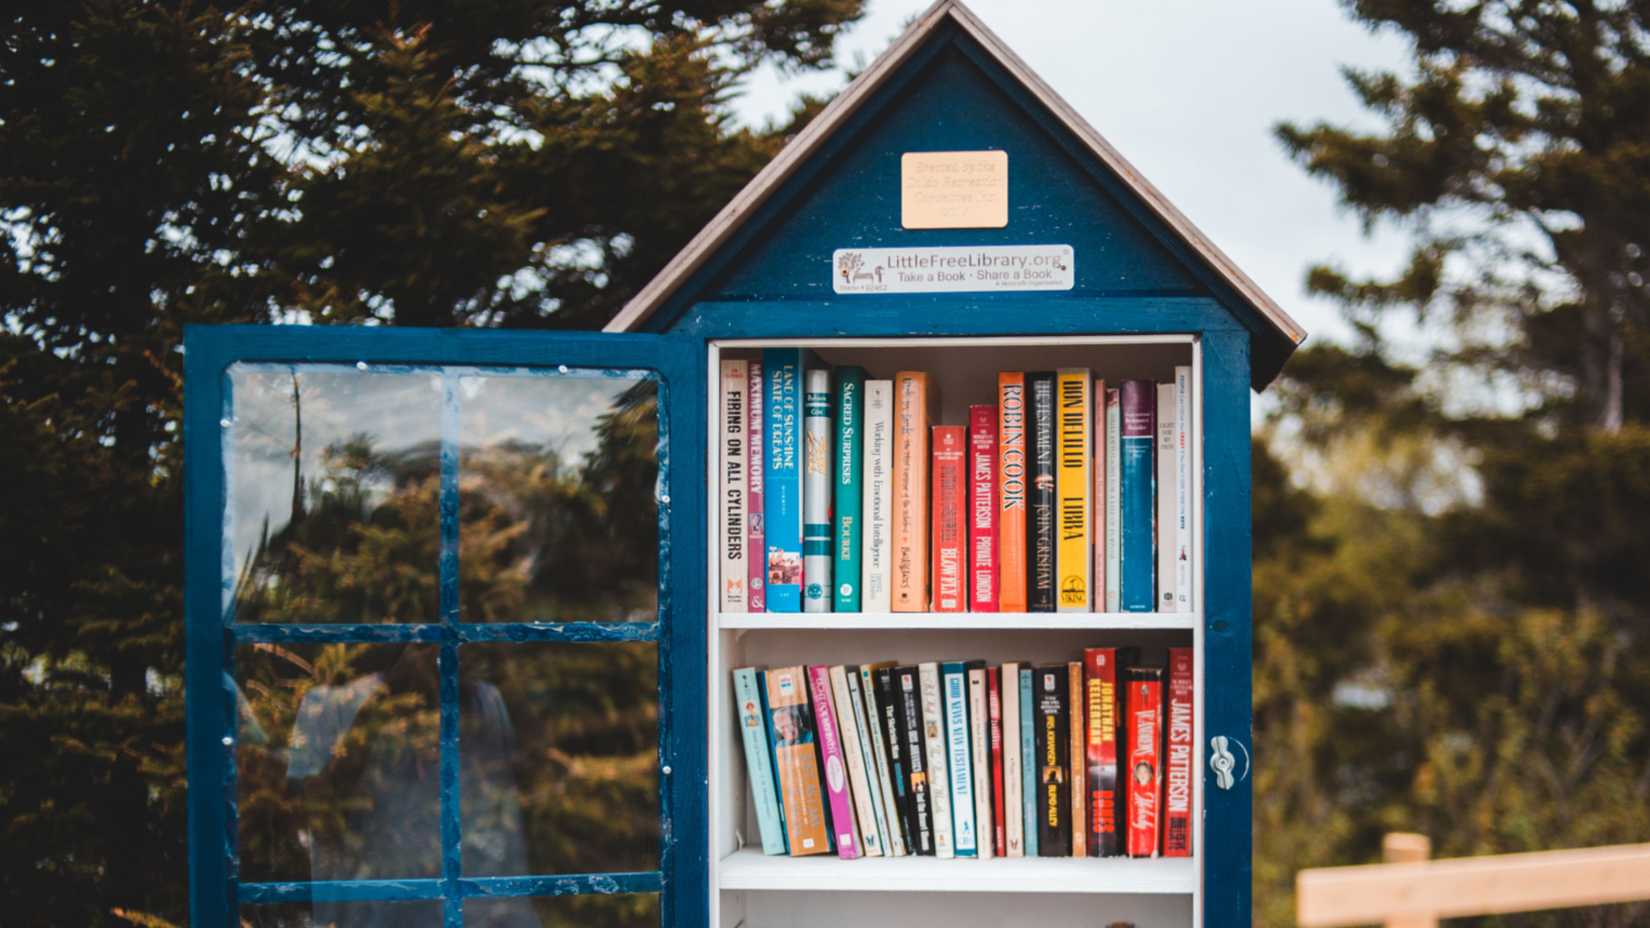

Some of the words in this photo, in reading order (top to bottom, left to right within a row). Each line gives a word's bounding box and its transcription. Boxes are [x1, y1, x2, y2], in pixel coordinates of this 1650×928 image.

[887, 252, 1062, 270] LittleFreeLibrary.org
[898, 271, 925, 283] Take
[927, 274, 934, 282] a
[937, 270, 966, 282] Book
[977, 269, 1011, 281] Share
[1013, 272, 1021, 280] a
[1024, 268, 1053, 280] Book
[751, 363, 763, 431] MAXIMUM
[772, 370, 782, 402] STATE
[783, 364, 793, 393] LAND
[1034, 380, 1051, 406] THE
[1063, 381, 1084, 408] DON
[727, 391, 742, 433] FIRING
[772, 405, 782, 421] OF
[783, 396, 793, 412] OF
[842, 382, 855, 425] SACRED
[1003, 383, 1024, 446] ROBIN
[727, 439, 742, 456] ON
[772, 424, 782, 470] DREAMS
[783, 415, 794, 470] SUNSHINE
[841, 427, 854, 485] SURPRISES
[870, 421, 884, 456] Working
[1037, 408, 1051, 465] TESTAMENT
[727, 461, 742, 484] ALL
[751, 433, 763, 495] MEMORY
[873, 459, 884, 477] with
[975, 452, 991, 480] JAMES
[1003, 448, 1024, 511] COOK
[873, 480, 884, 521] Emotional
[975, 482, 991, 529] PATTERSON
[1034, 504, 1052, 534] JOHN
[1063, 497, 1084, 541] LIBRA
[727, 490, 742, 560] CYLINDERS
[841, 516, 853, 560] BOURKE
[870, 523, 884, 568] Intelligence
[976, 536, 992, 567] PRIVATE
[1037, 537, 1052, 590] GRISHAM
[976, 569, 992, 603] LONDON
[951, 700, 962, 724] NEWS
[1087, 678, 1102, 744] KELLERMAN
[1102, 682, 1114, 741] JONATHAN
[1171, 699, 1190, 741] JAMES
[953, 727, 964, 746] NEW
[954, 748, 967, 795] TESTAMENT
[1168, 745, 1190, 812] PATTERSON
[1092, 790, 1115, 833] BONES
